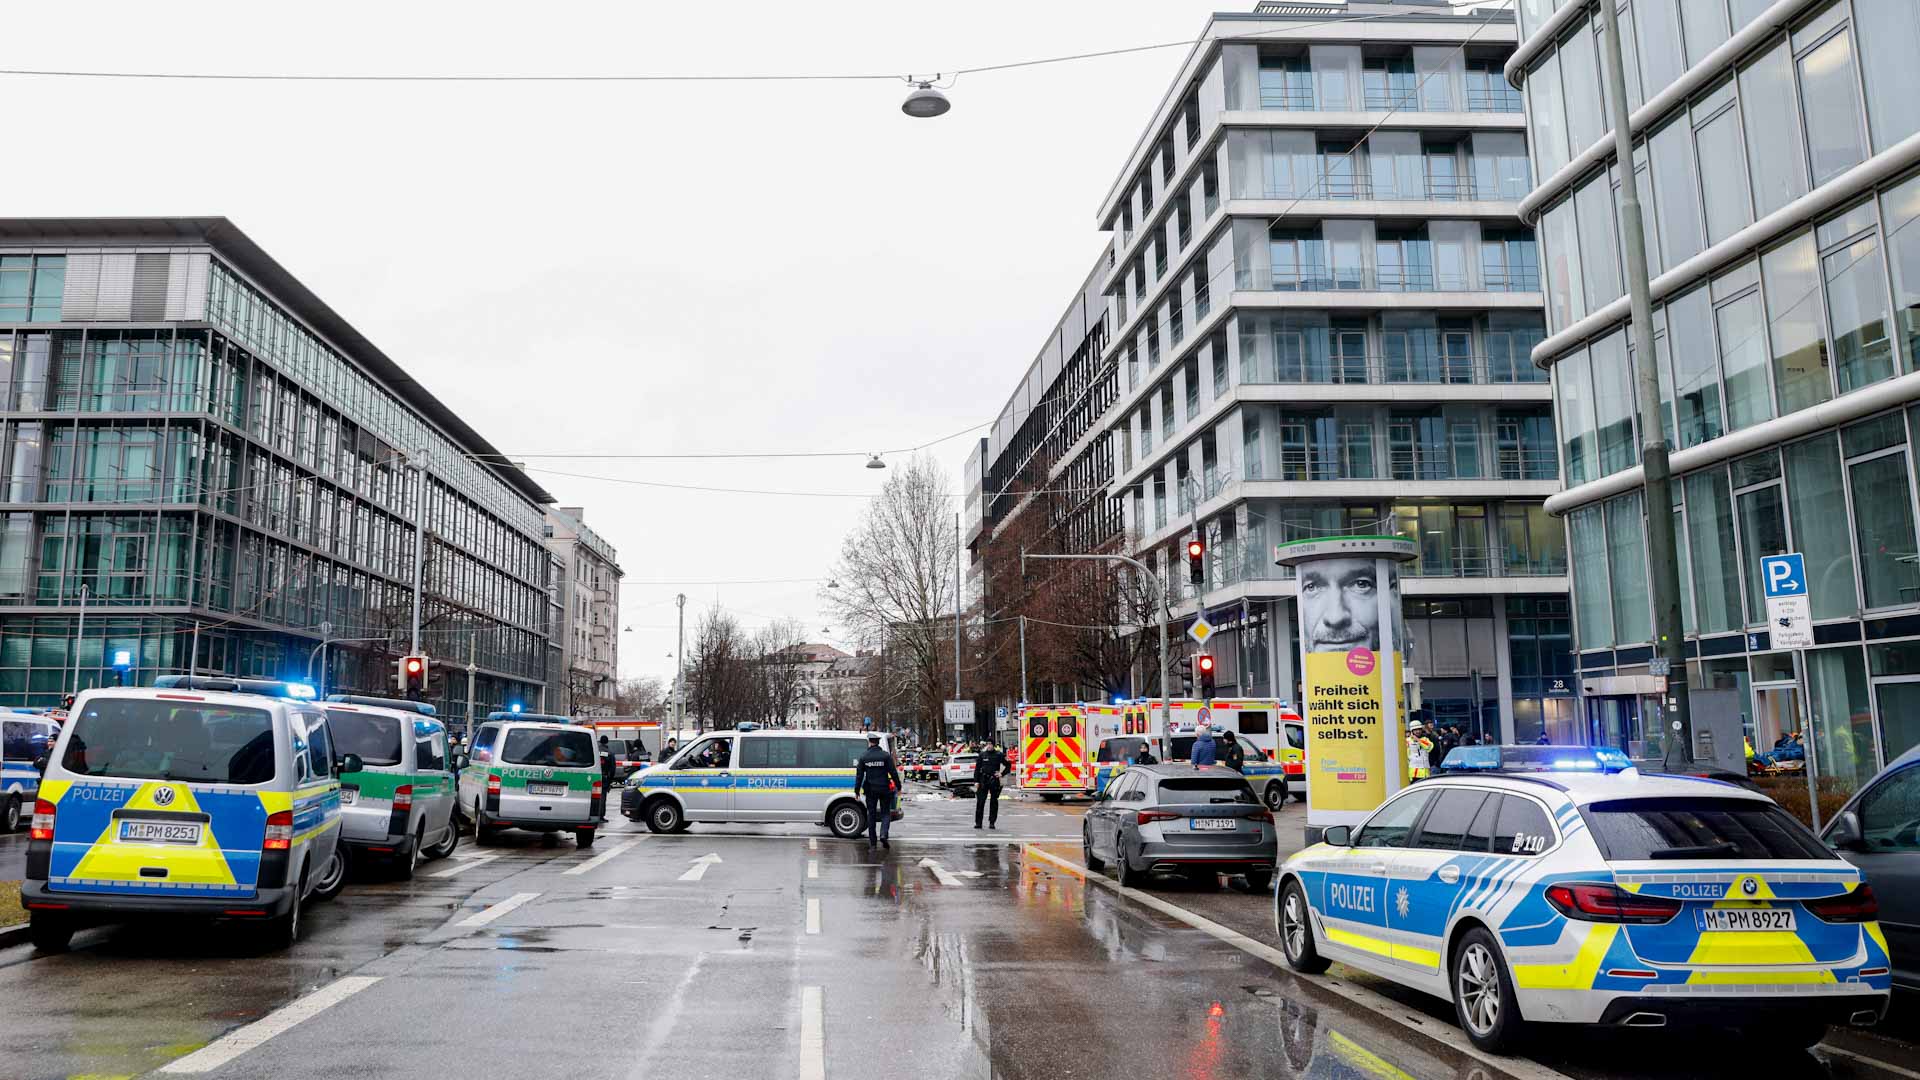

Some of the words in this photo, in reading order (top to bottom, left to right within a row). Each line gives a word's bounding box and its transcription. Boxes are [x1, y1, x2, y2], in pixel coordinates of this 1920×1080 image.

[1768, 560, 1792, 592] P
[1553, 680, 1564, 688] 28
[1314, 685, 1369, 696] Freiheit
[1309, 699, 1344, 710] wählt
[1347, 699, 1379, 710] sich
[1312, 714, 1344, 725] nicht
[1348, 716, 1376, 724] von
[1318, 728, 1368, 739] selbst.
[502, 768, 542, 778] POLIZEI
[748, 778, 787, 788] POLIZEI
[73, 788, 124, 801] POLIZEI
[129, 825, 139, 837] M
[146, 826, 162, 838] PM
[164, 827, 195, 840] 8251
[1523, 835, 1545, 851] 110
[1672, 885, 1723, 896] POLIZEI
[1331, 883, 1374, 913] POLIZEI
[1705, 912, 1718, 928] M
[1727, 912, 1750, 928] PM
[1752, 912, 1790, 928] 8927
